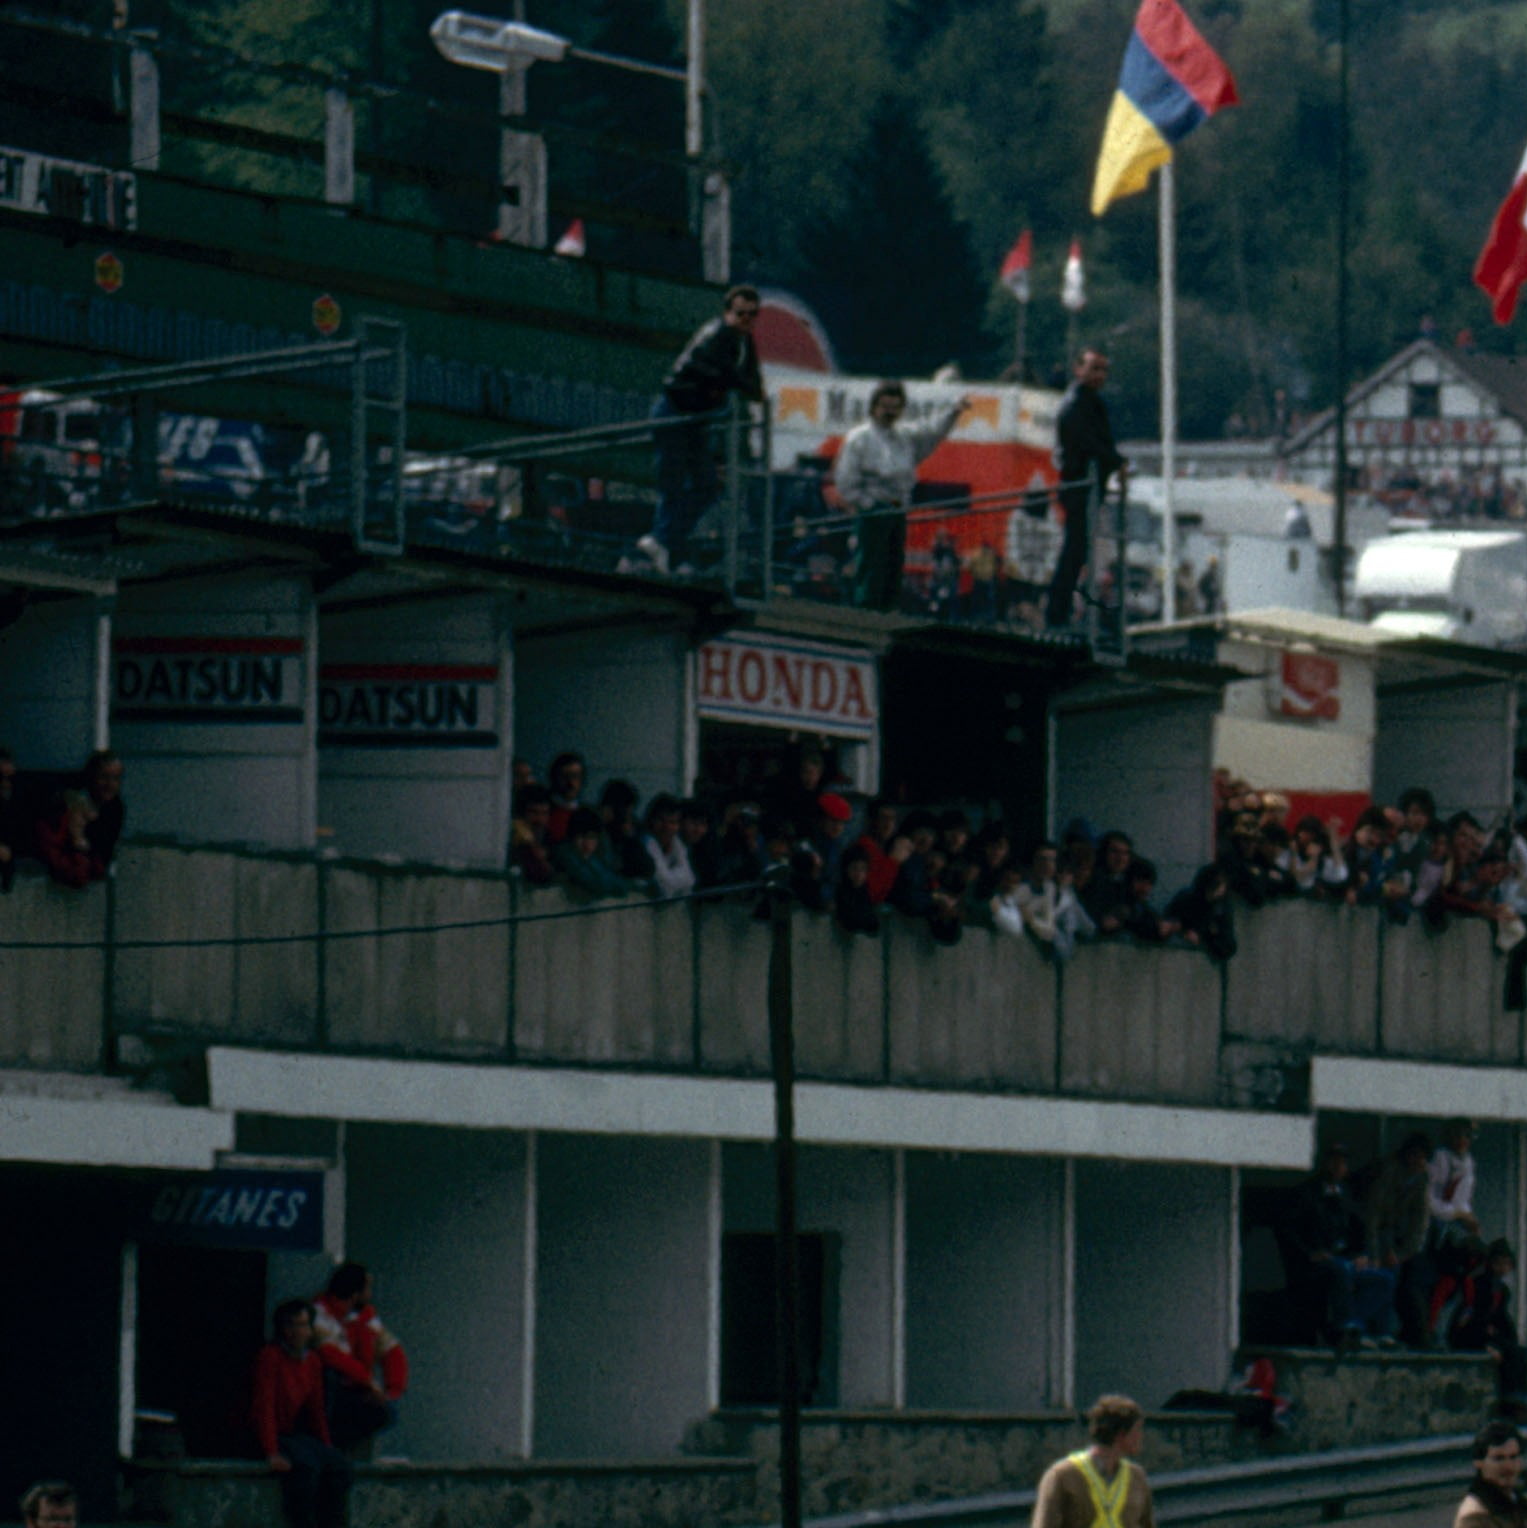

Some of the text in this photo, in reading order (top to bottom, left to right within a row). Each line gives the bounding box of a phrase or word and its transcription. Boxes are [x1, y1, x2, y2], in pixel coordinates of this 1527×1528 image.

[1352, 418, 1497, 444] TUBORG
[118, 657, 284, 702] DATSUN
[701, 645, 877, 719] HONDA
[320, 685, 479, 727] DATSUN
[151, 1184, 308, 1229] GITANES
